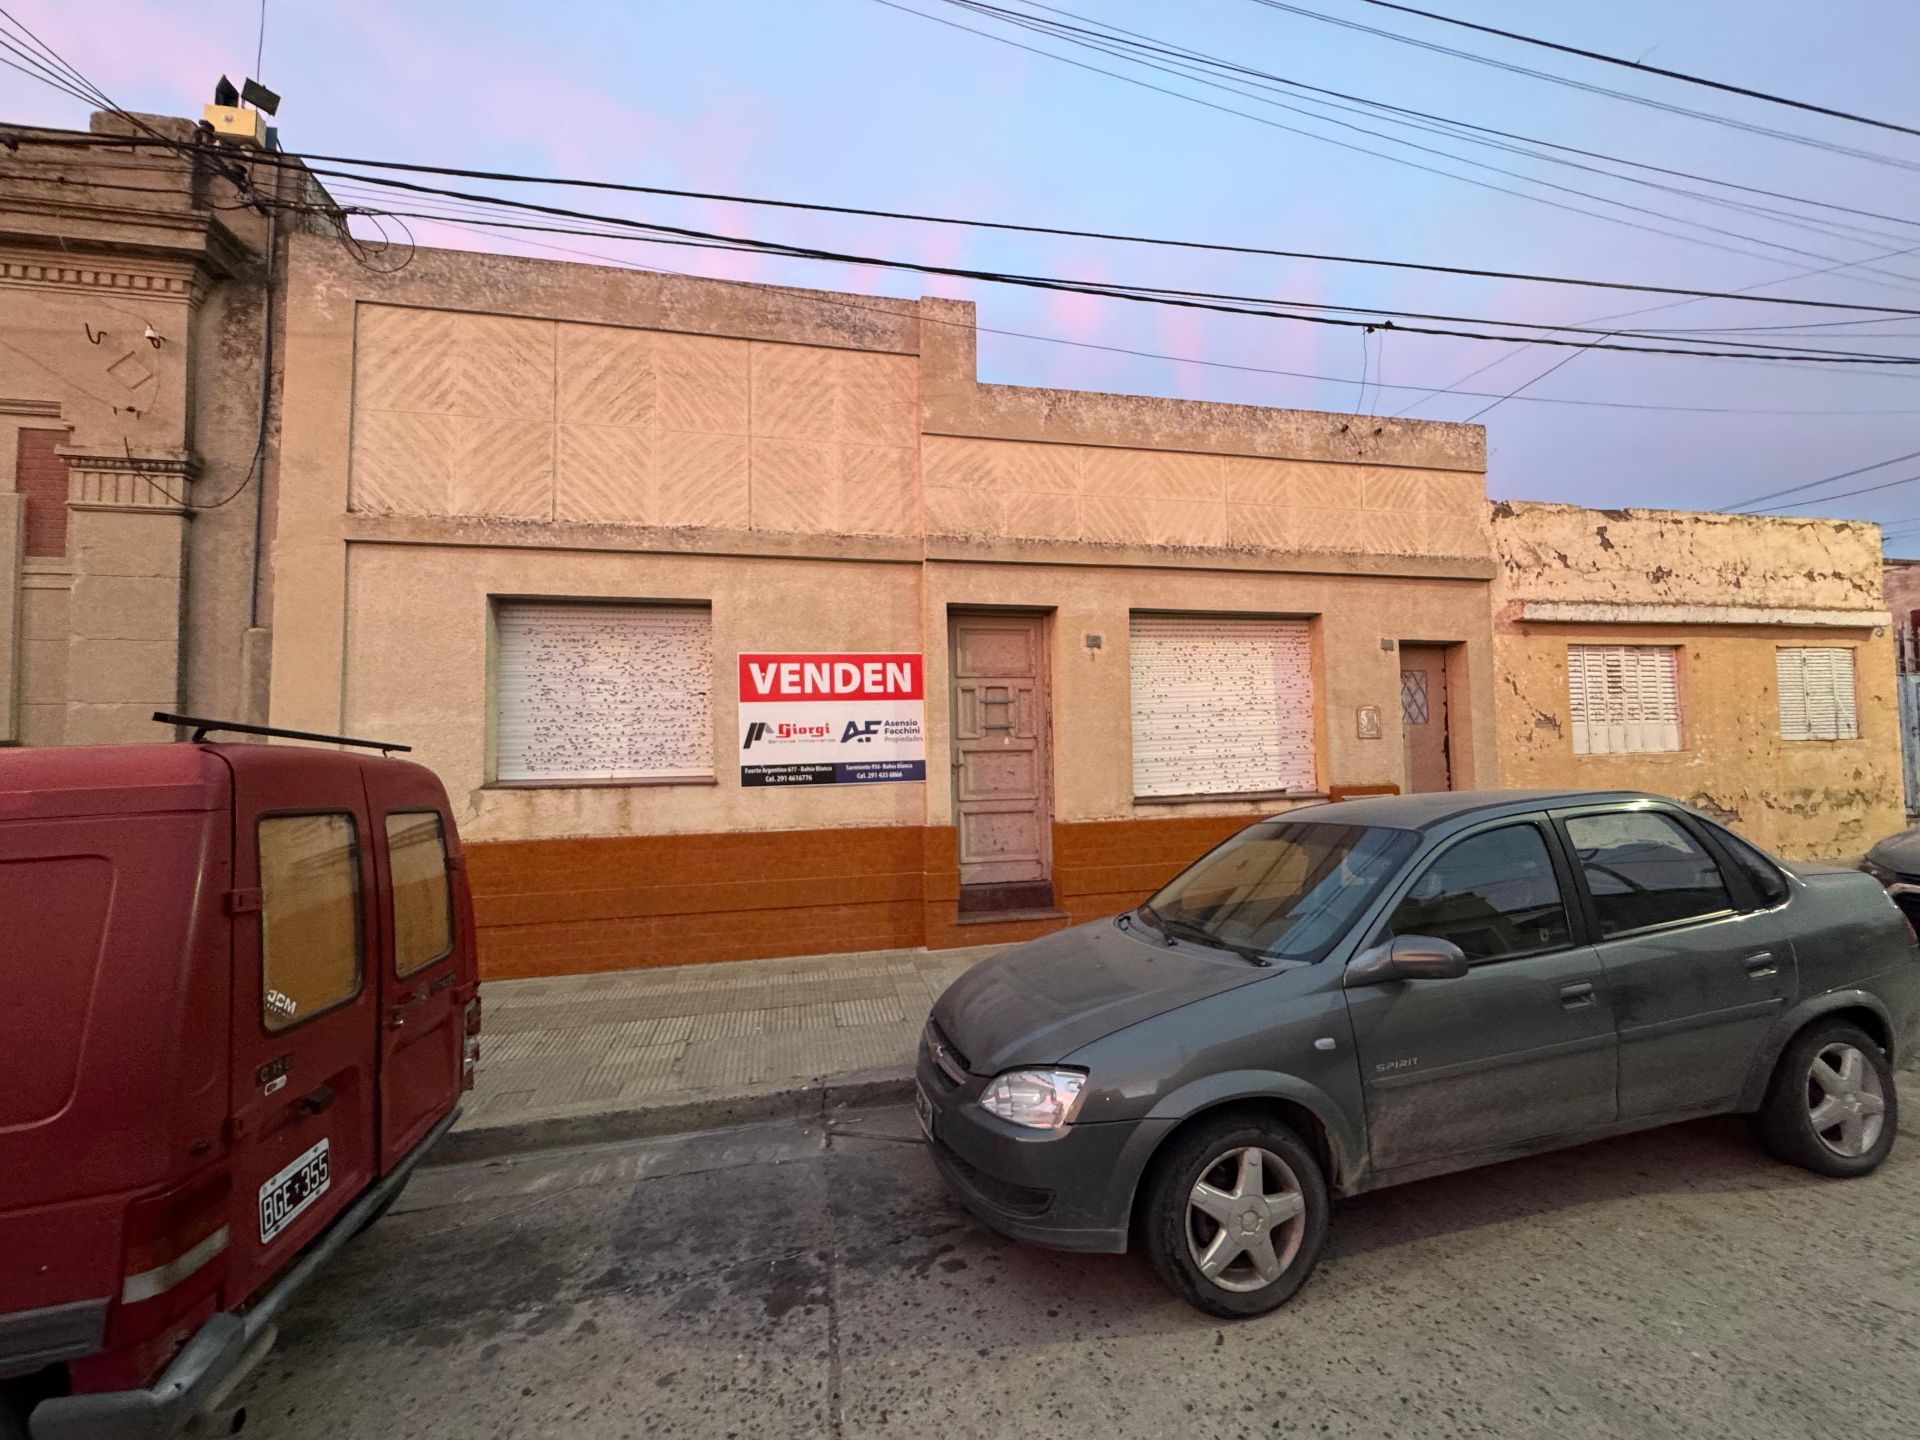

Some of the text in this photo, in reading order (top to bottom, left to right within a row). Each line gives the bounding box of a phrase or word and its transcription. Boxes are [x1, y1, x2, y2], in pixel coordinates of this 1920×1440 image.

[749, 663, 912, 694] VENDEN
[884, 719, 918, 727] Asensio
[776, 723, 830, 738] Giorgi
[840, 720, 882, 743] AF
[884, 727, 920, 735] Facchini
[884, 736, 924, 744] Propiedades
[762, 766, 787, 775] Argentino
[867, 771, 878, 779] 291
[777, 774, 787, 782] 291
[267, 989, 297, 1014] JCM
[1376, 1057, 1418, 1072] SPIRIT
[263, 1152, 328, 1230] BGE 355
